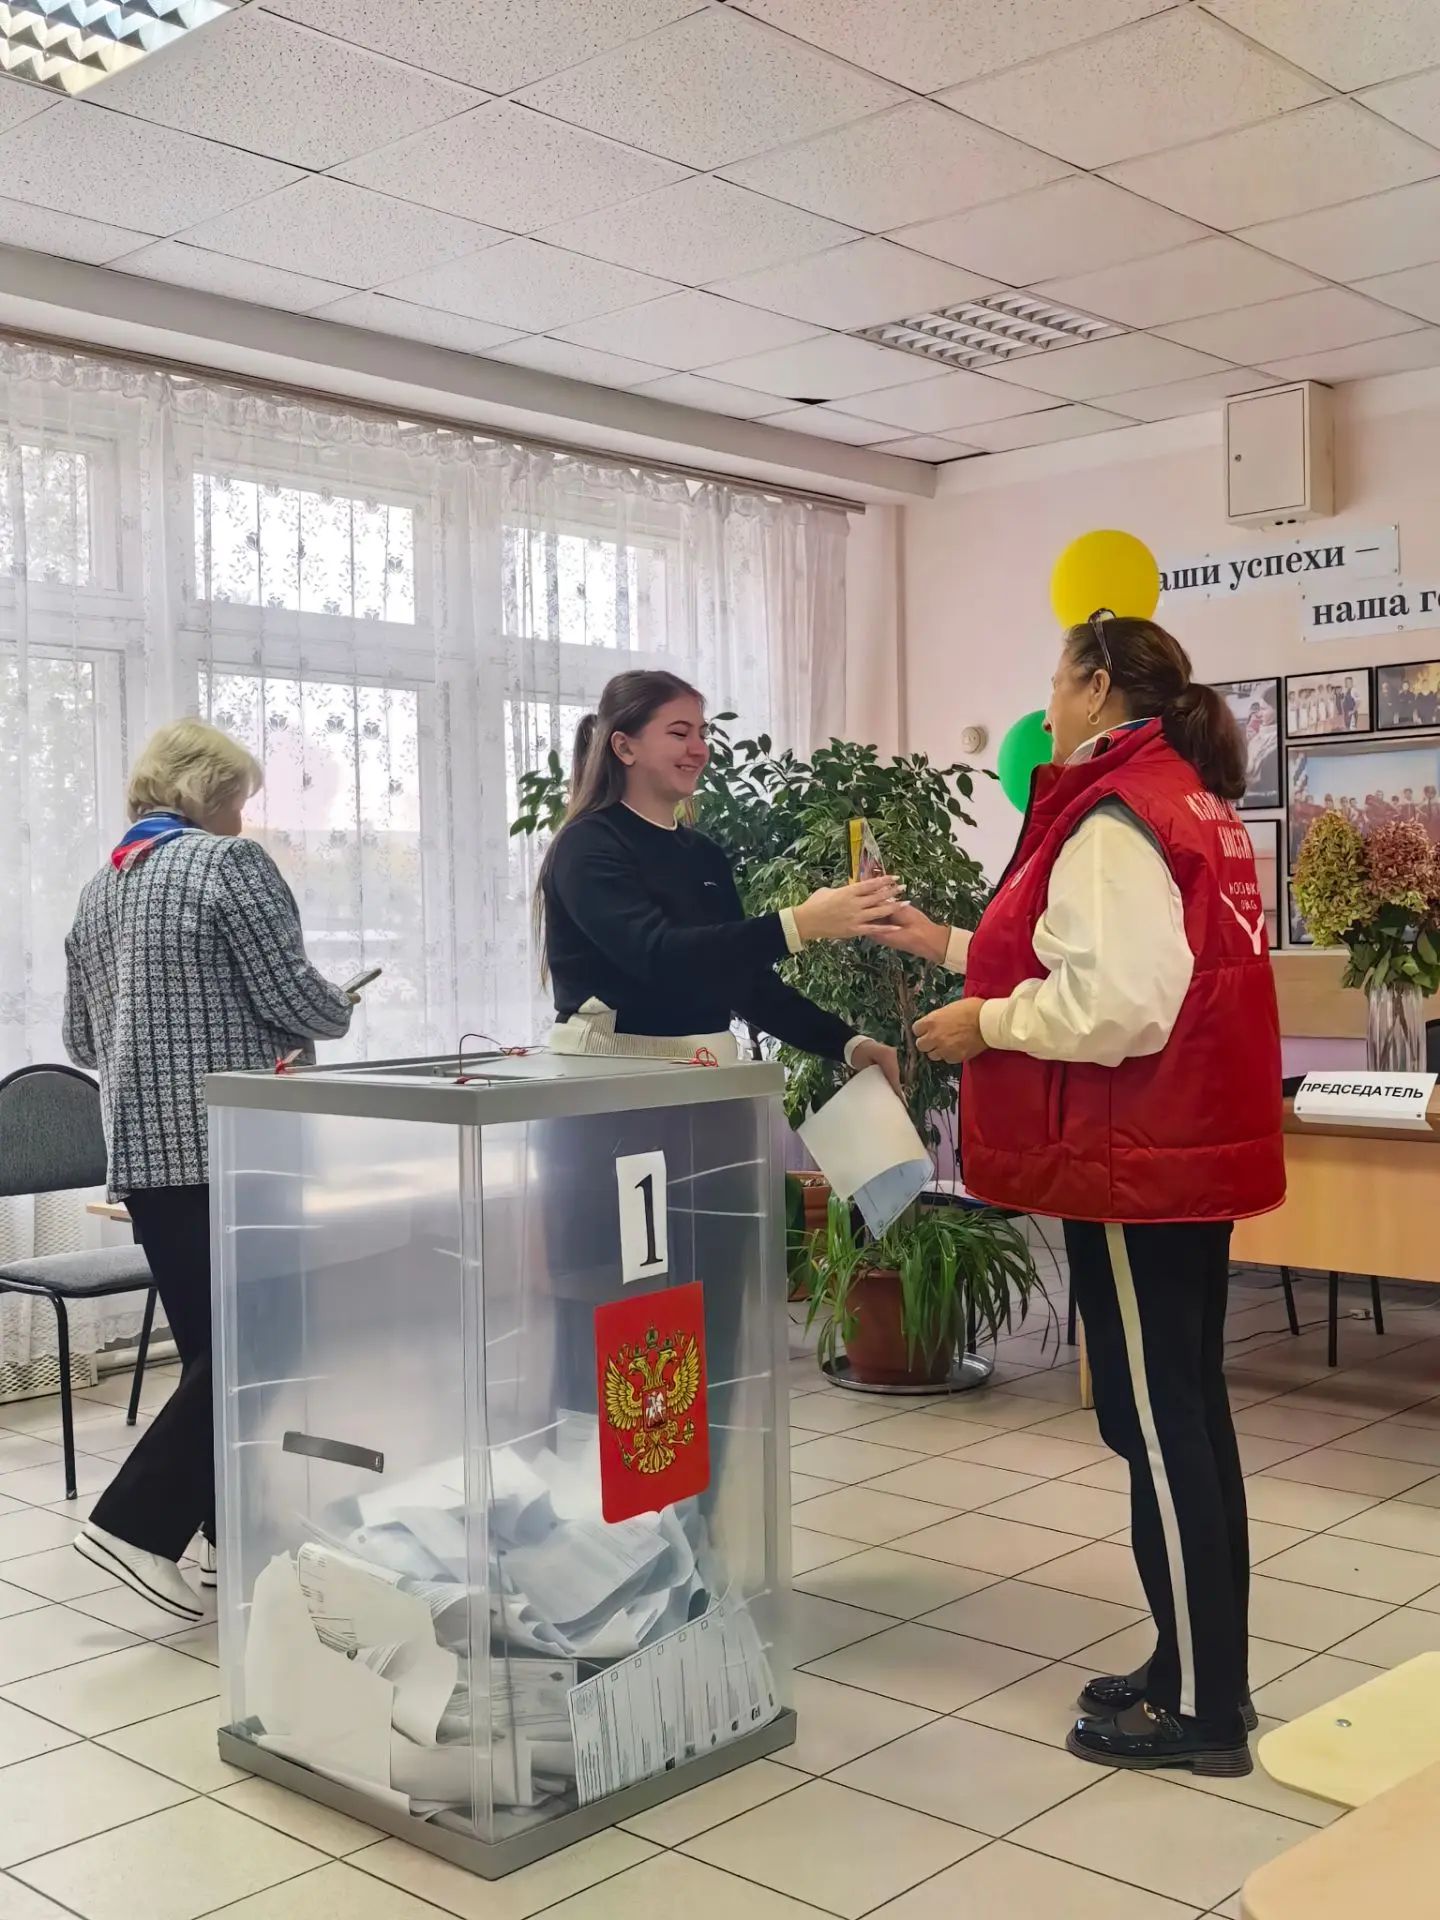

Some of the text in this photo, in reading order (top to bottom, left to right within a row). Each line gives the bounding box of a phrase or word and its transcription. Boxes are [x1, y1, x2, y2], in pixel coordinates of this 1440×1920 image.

[1159, 564, 1221, 591] аши
[1229, 545, 1346, 591] успехи
[1312, 590, 1440, 626] наша г
[1300, 1083, 1424, 1099] ПРЕДСЕДАТЕЛЬ
[634, 1173, 664, 1267] 1
